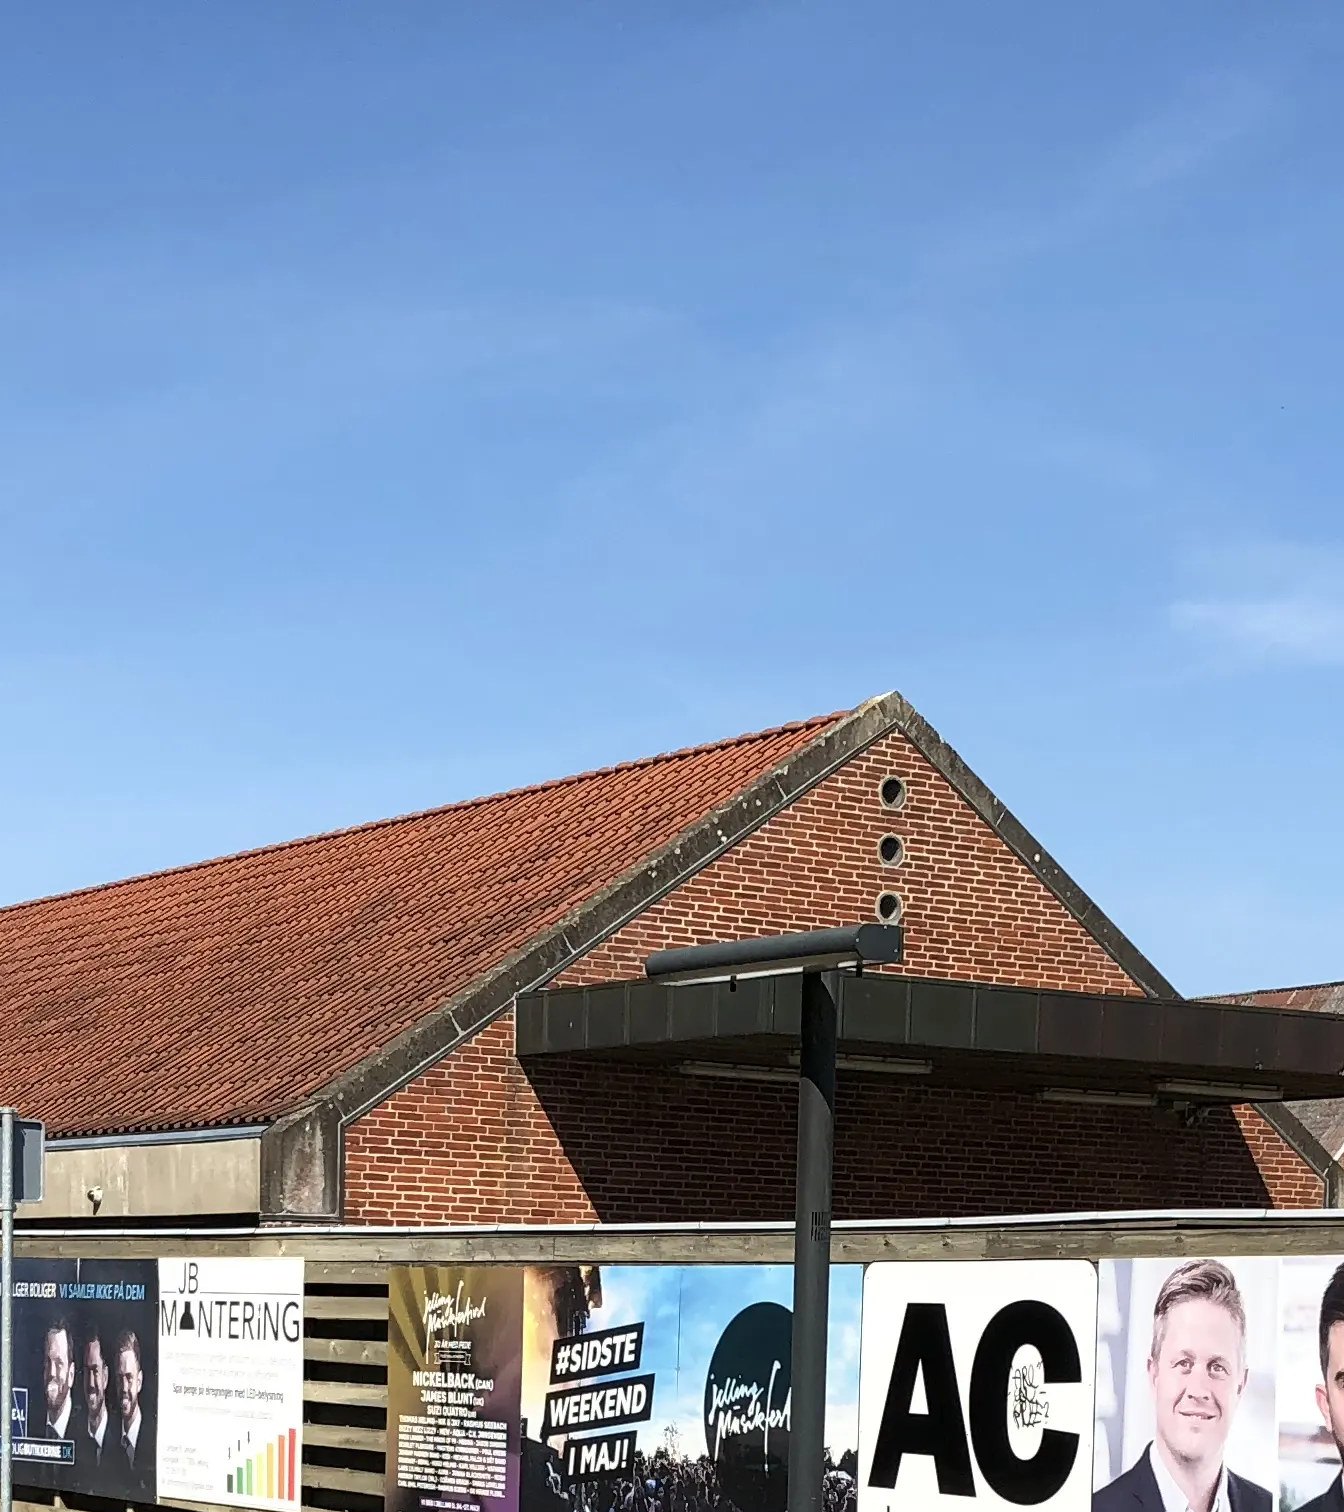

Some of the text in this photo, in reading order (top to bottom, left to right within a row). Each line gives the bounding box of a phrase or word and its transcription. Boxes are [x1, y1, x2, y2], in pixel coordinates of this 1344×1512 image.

[59, 1284, 67, 1298] VI
[68, 1284, 95, 1299] SAMLER
[113, 1281, 124, 1300] PÅ
[125, 1284, 145, 1300] DEM
[178, 1262, 199, 1294] JB
[555, 1331, 638, 1376] #SIDSTE
[413, 1371, 494, 1391] NICKELBACK (CAN)
[420, 1390, 447, 1404] JAMES
[448, 1391, 474, 1405] BLUNT
[427, 1405, 442, 1415] SUZI
[443, 1406, 468, 1418] QUATRO
[550, 1382, 647, 1427] WEEKEND
[867, 1299, 1082, 1506] AC
[568, 1437, 629, 1475] I MAJ!
